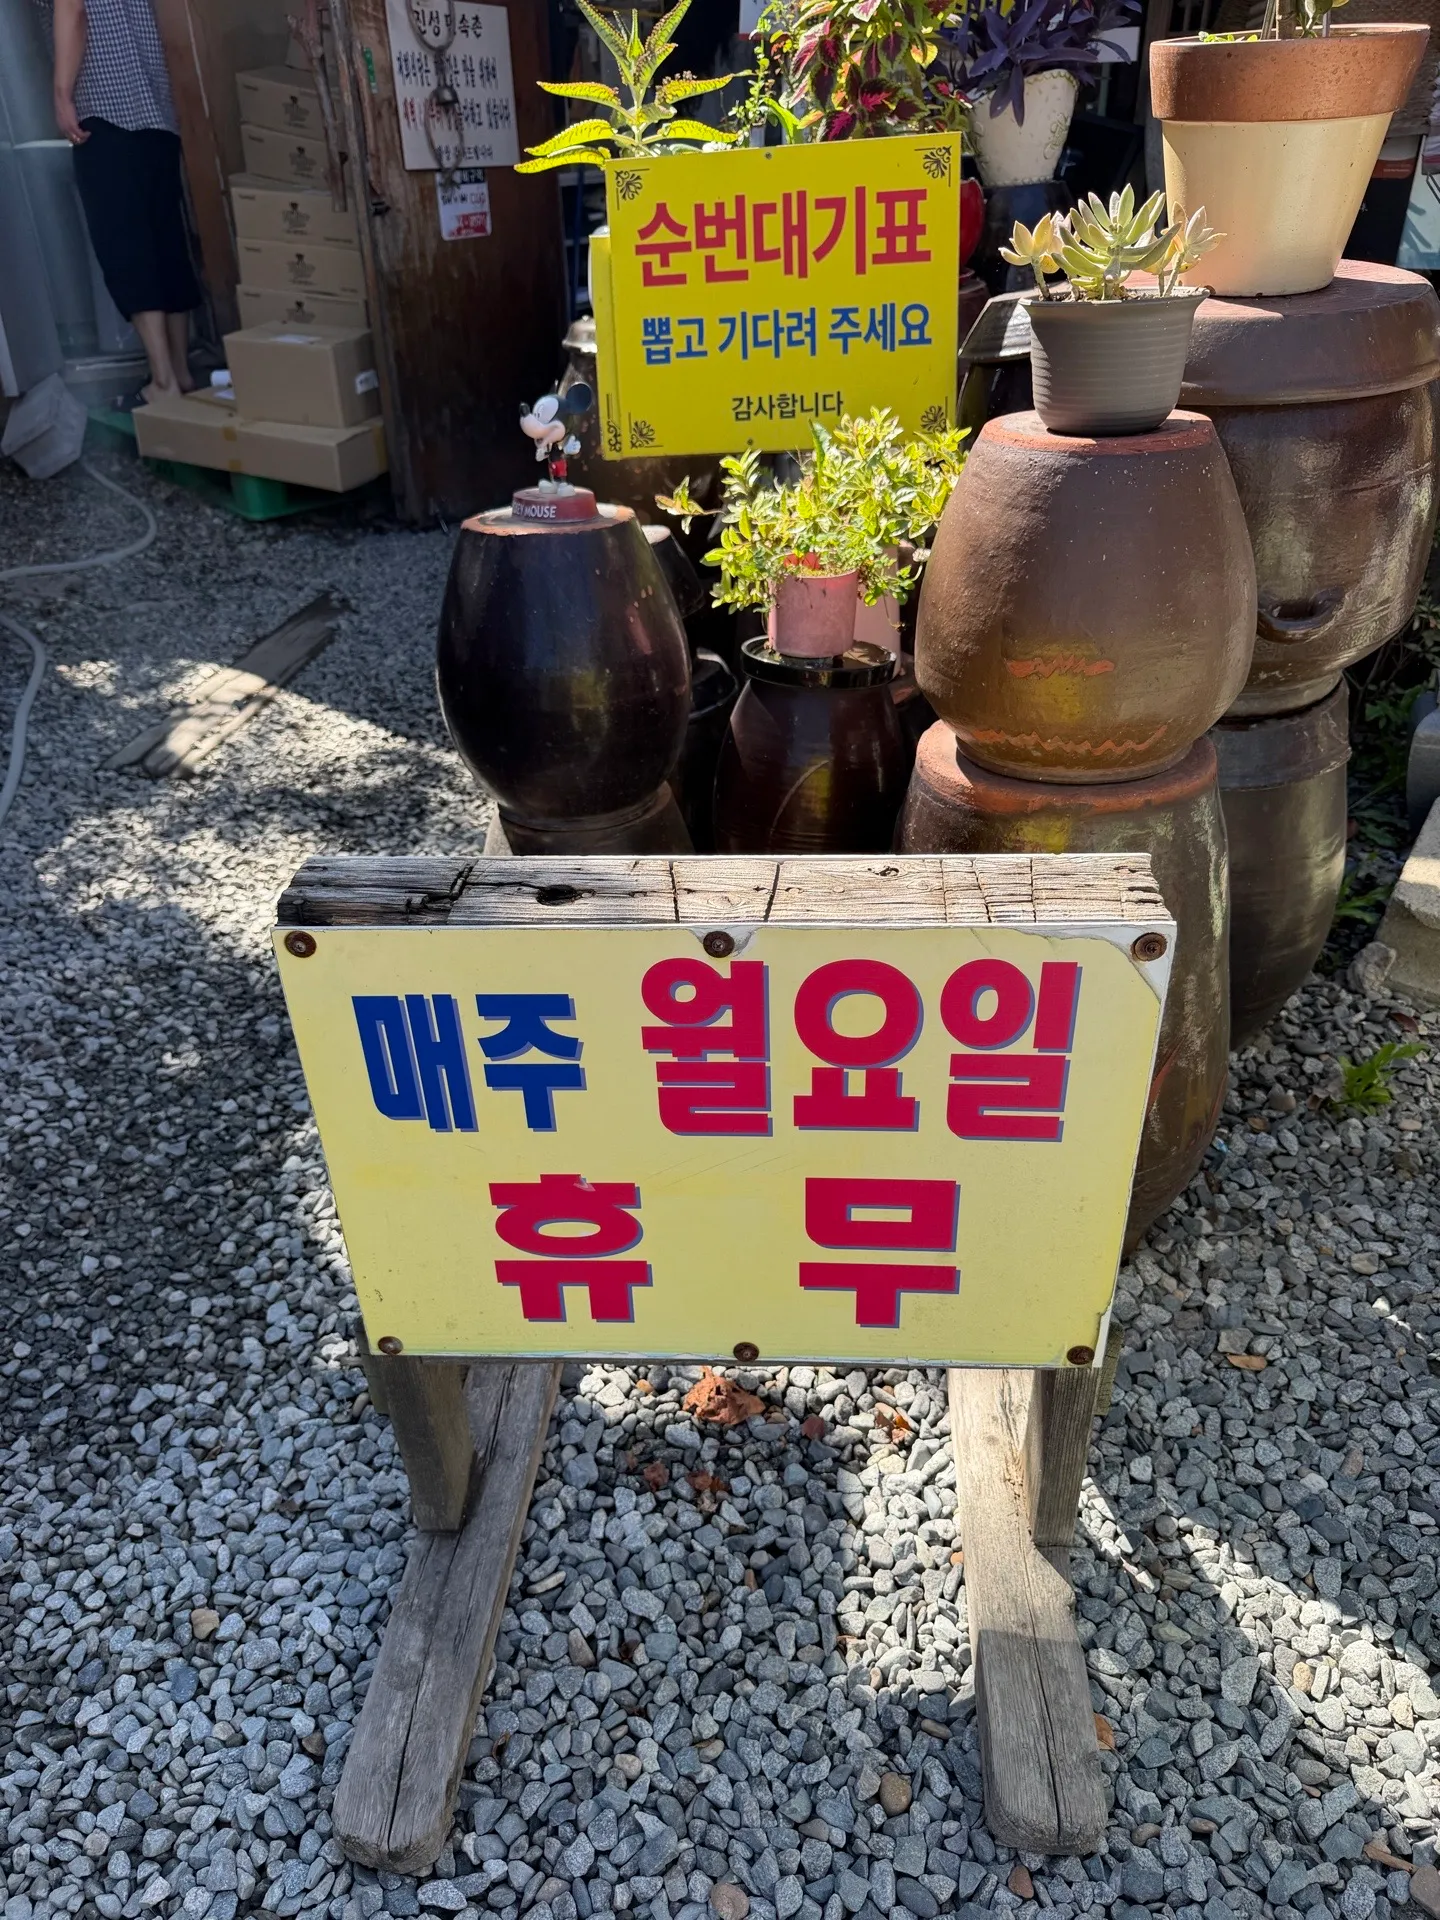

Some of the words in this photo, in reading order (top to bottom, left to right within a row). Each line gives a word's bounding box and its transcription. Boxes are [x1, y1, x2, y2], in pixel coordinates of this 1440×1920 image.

[634, 185, 932, 287] 순번대기표
[641, 316, 709, 366] 뽑고
[718, 307, 817, 361] 기다려
[828, 303, 933, 355] 주세요
[731, 390, 845, 422] 감사합니다
[524, 505, 558, 518] MOUSE
[352, 993, 587, 1133] 매주
[641, 957, 1083, 1143] 월요일
[488, 1174, 654, 1324] 휴
[799, 1177, 961, 1329] 무
